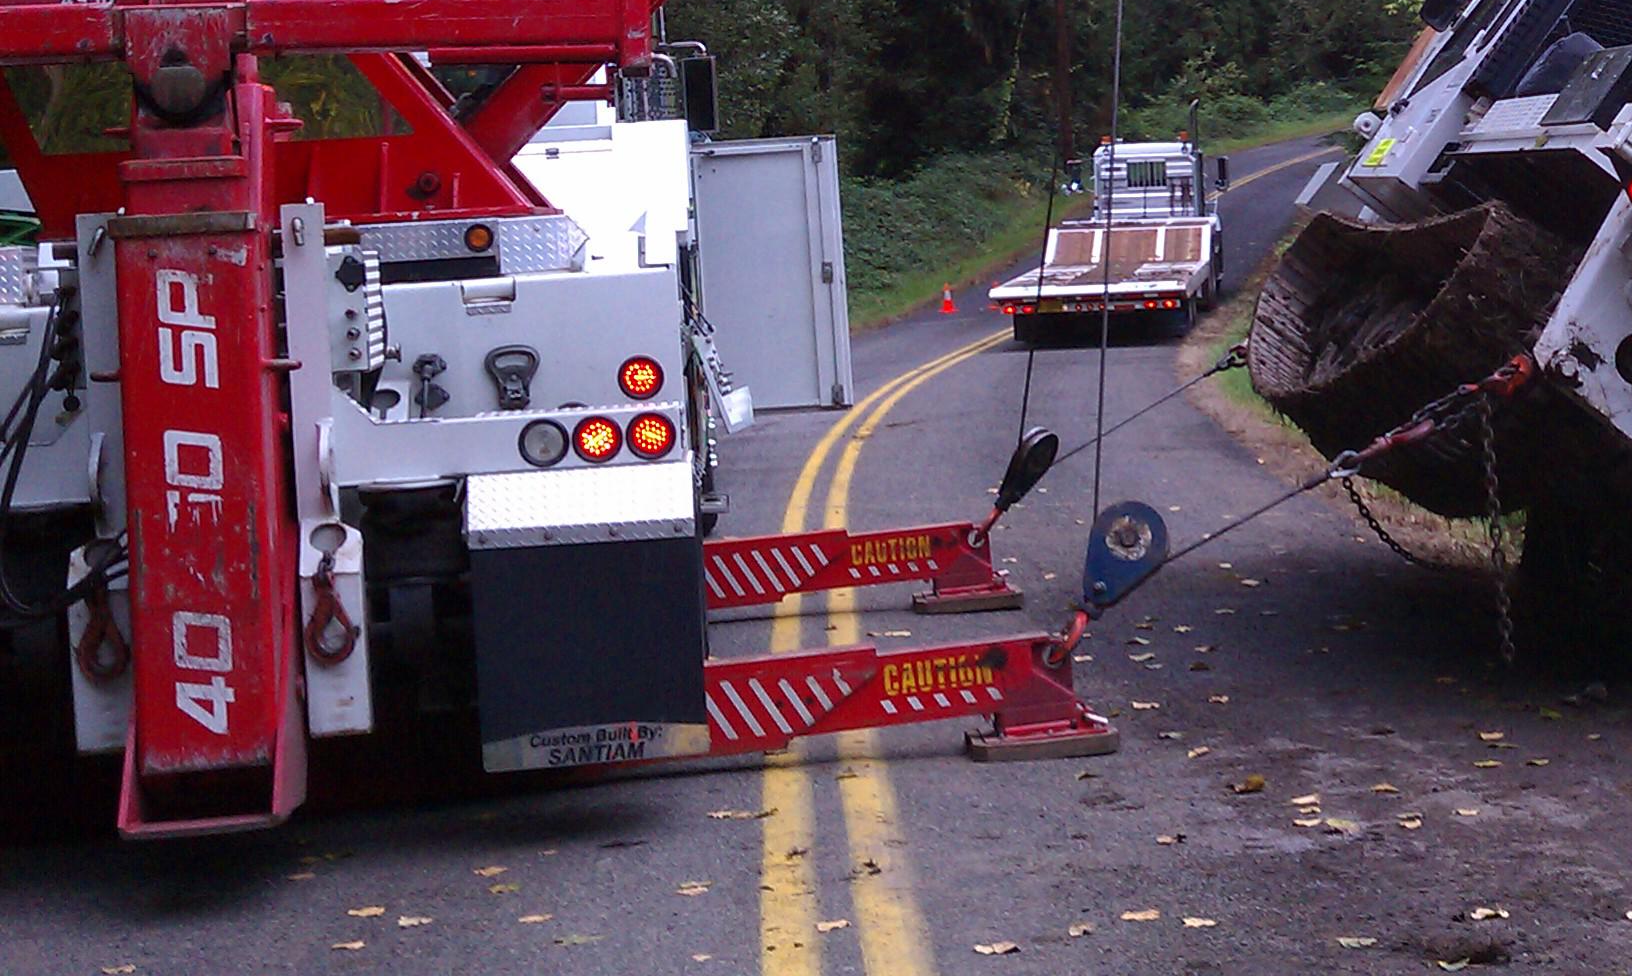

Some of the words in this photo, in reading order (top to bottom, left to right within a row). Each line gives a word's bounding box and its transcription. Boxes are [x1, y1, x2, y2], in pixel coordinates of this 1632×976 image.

[850, 535, 932, 566] CAUTION
[172, 610, 236, 735] 40
[882, 654, 994, 697] CAUTION
[529, 731, 592, 748] Custom
[595, 726, 634, 743] Built
[549, 740, 645, 766] SANTIAM
